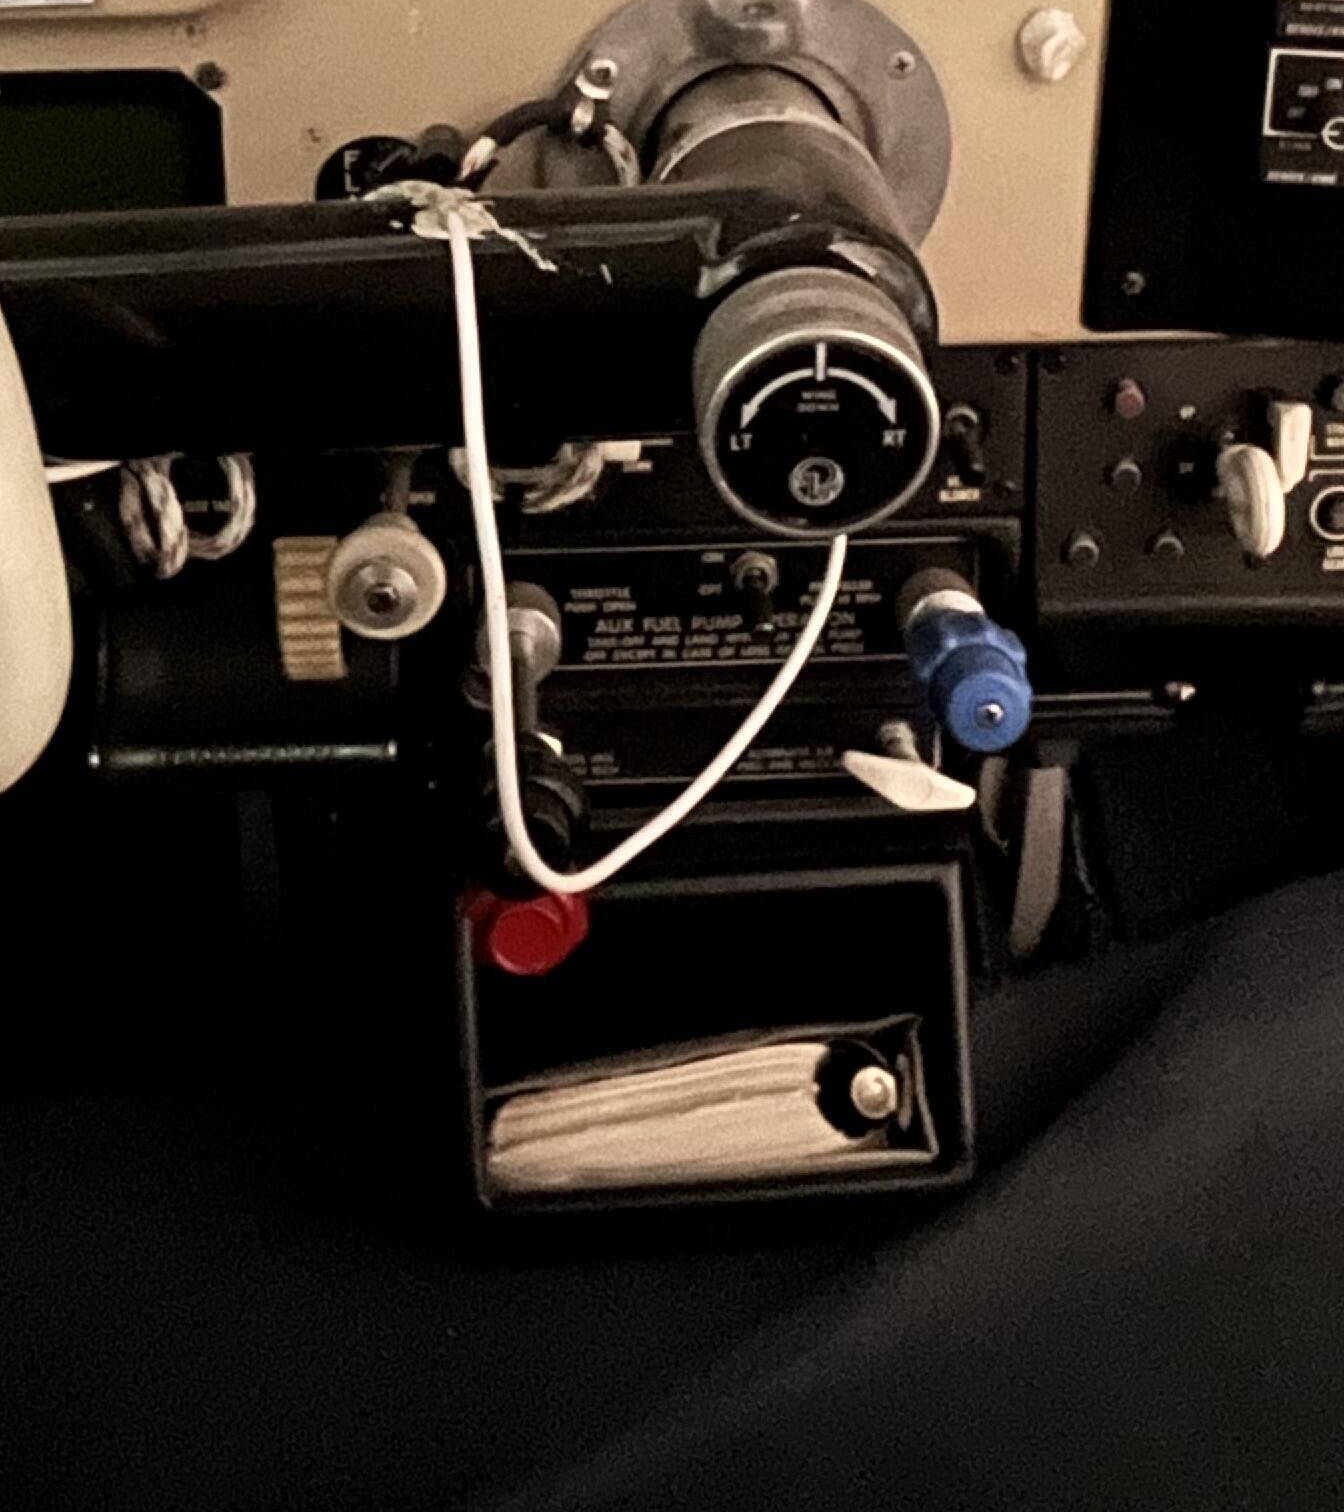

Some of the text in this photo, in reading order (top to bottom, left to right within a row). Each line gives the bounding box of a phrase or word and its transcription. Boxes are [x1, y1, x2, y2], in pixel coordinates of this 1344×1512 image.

[730, 433, 754, 452] LT
[882, 428, 908, 449] RT
[595, 613, 744, 634] AUX FUEL PUMP
